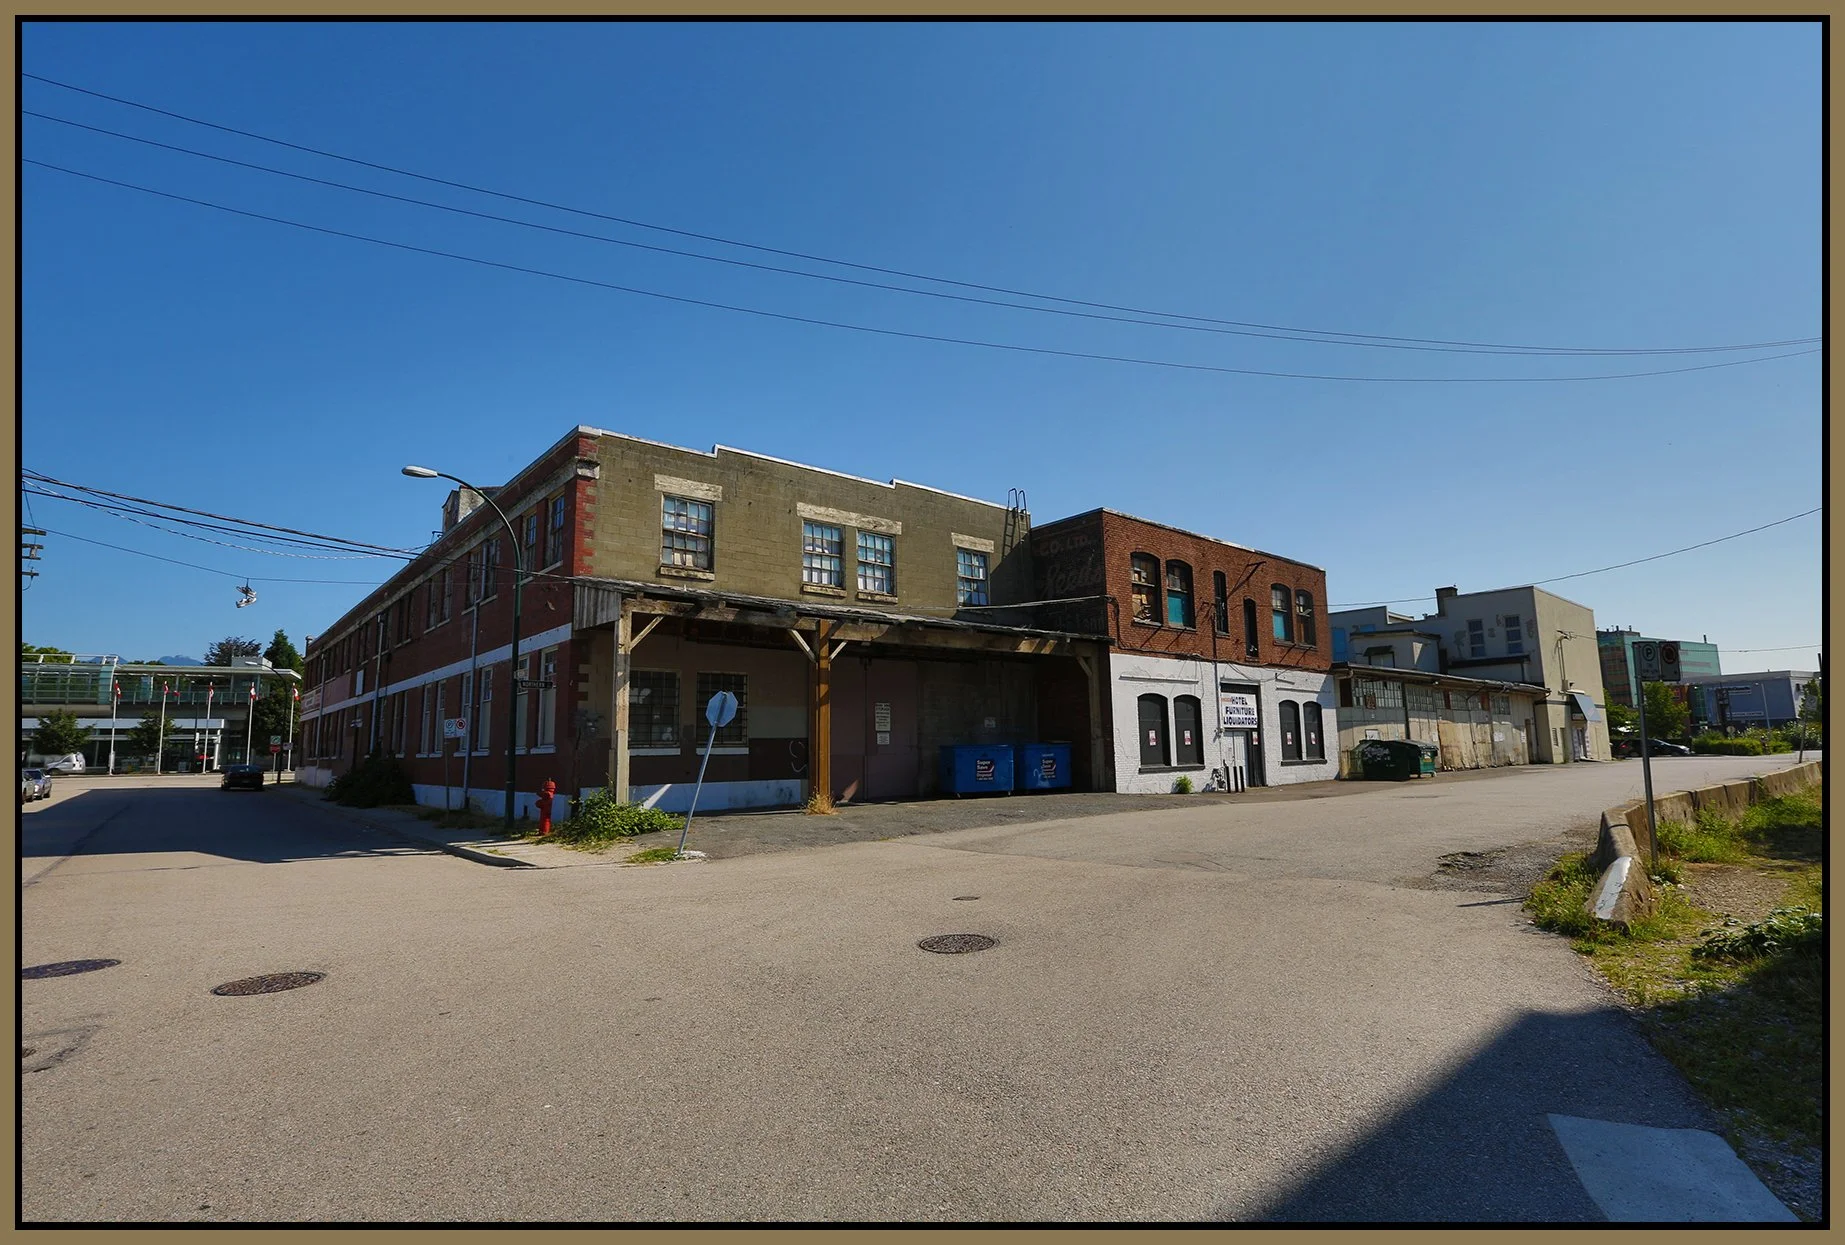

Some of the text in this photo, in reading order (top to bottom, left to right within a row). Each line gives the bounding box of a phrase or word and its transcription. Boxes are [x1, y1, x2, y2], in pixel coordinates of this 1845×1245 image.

[1231, 696, 1248, 704] HOTEL
[1225, 706, 1255, 715] FURNITURE
[1223, 716, 1258, 725] LIQUIDATORS
